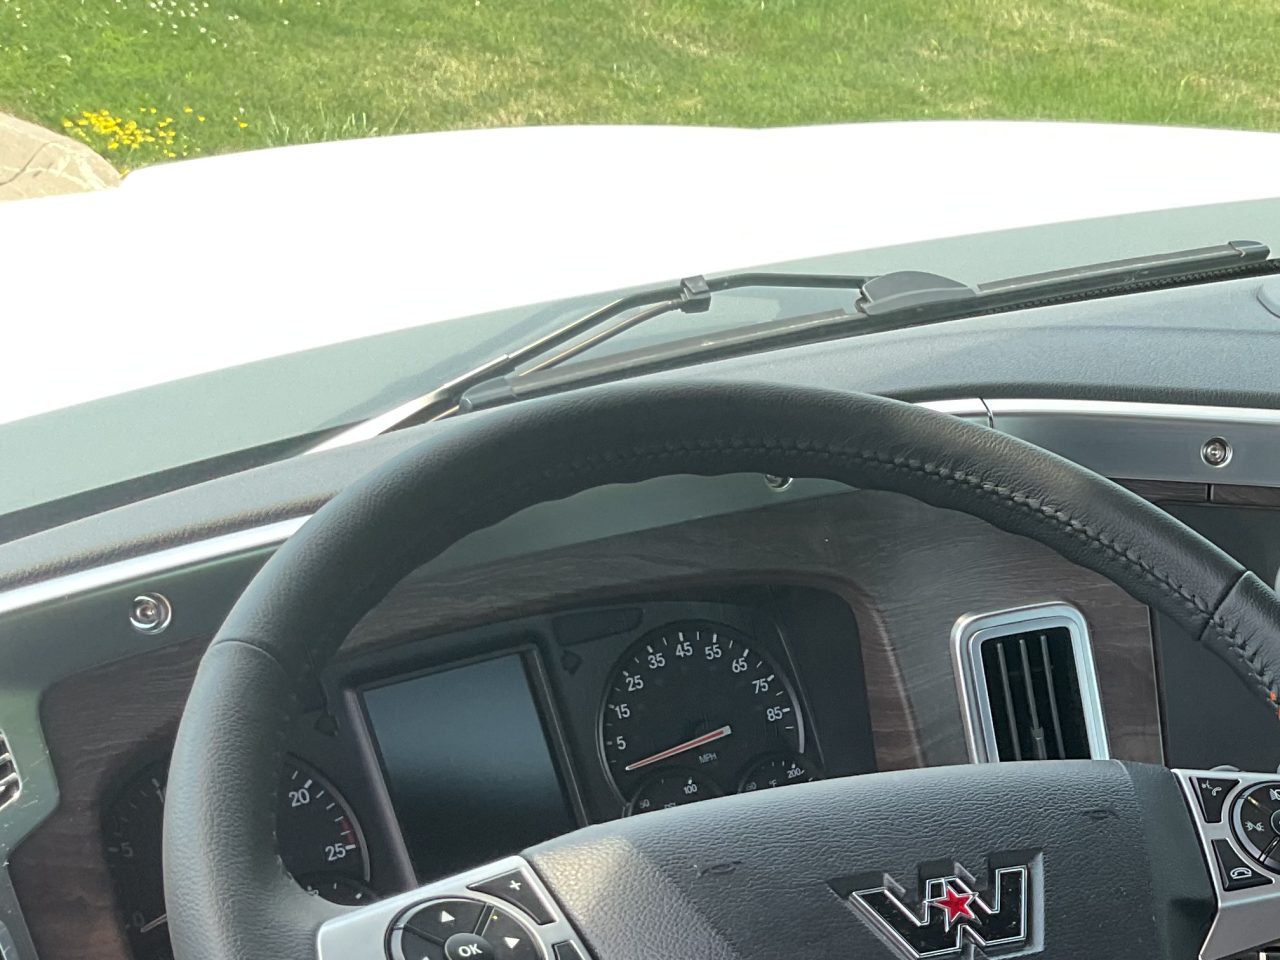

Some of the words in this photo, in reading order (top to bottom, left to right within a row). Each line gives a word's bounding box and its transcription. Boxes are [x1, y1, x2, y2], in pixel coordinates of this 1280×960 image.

[675, 642, 693, 658] 45
[705, 644, 722, 660] 55
[648, 652, 666, 669] 35
[732, 657, 748, 673] 65
[625, 675, 644, 692] 25
[752, 679, 769, 694] 75
[614, 704, 631, 719] 15
[766, 706, 783, 721] 85
[617, 736, 626, 750] 5
[699, 752, 717, 764] MPH
[787, 768, 801, 779] 200
[683, 784, 698, 795] 100
[289, 788, 310, 808] 20
[120, 842, 133, 858] 5
[325, 843, 346, 861] 25
[458, 943, 483, 958] OK
